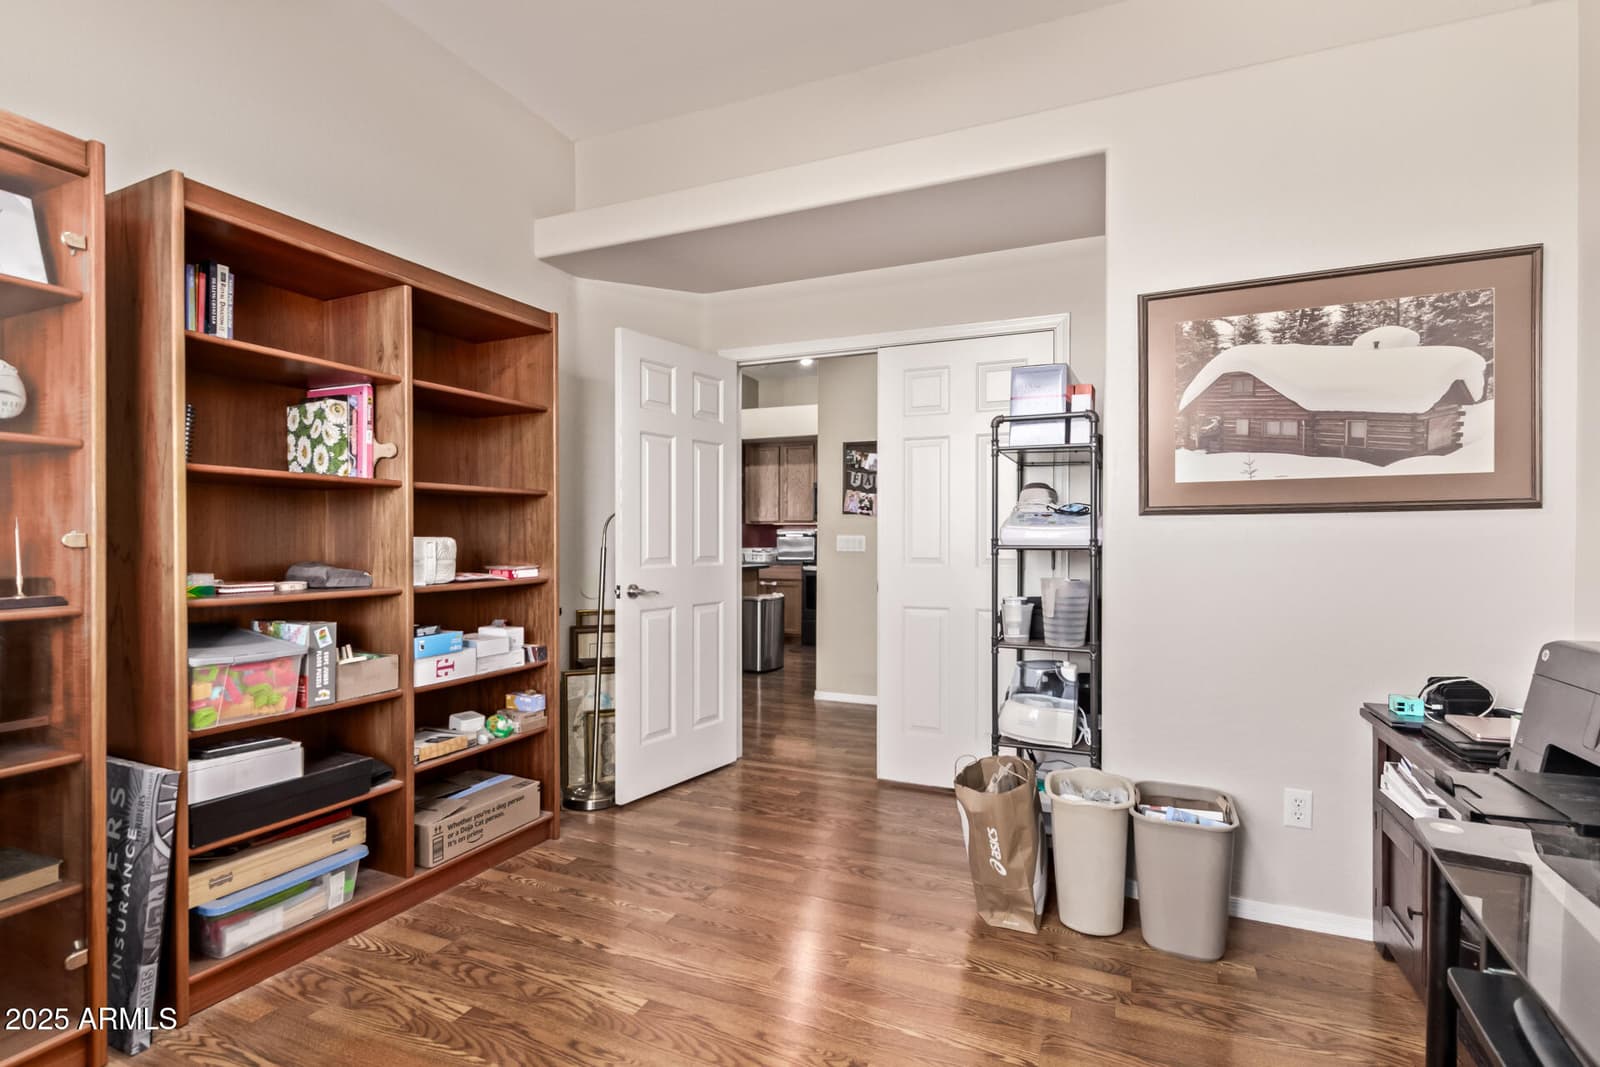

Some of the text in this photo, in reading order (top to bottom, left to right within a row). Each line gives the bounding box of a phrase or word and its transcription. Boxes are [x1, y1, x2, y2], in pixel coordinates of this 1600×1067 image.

[447, 816, 473, 831] Whether
[473, 808, 491, 821] you're
[496, 802, 507, 811] dog
[507, 795, 525, 807] person
[447, 832, 454, 840] or
[460, 824, 474, 835] Doja
[474, 819, 485, 828] Cat
[466, 828, 484, 841] prime
[111, 827, 138, 980] INSURANCE
